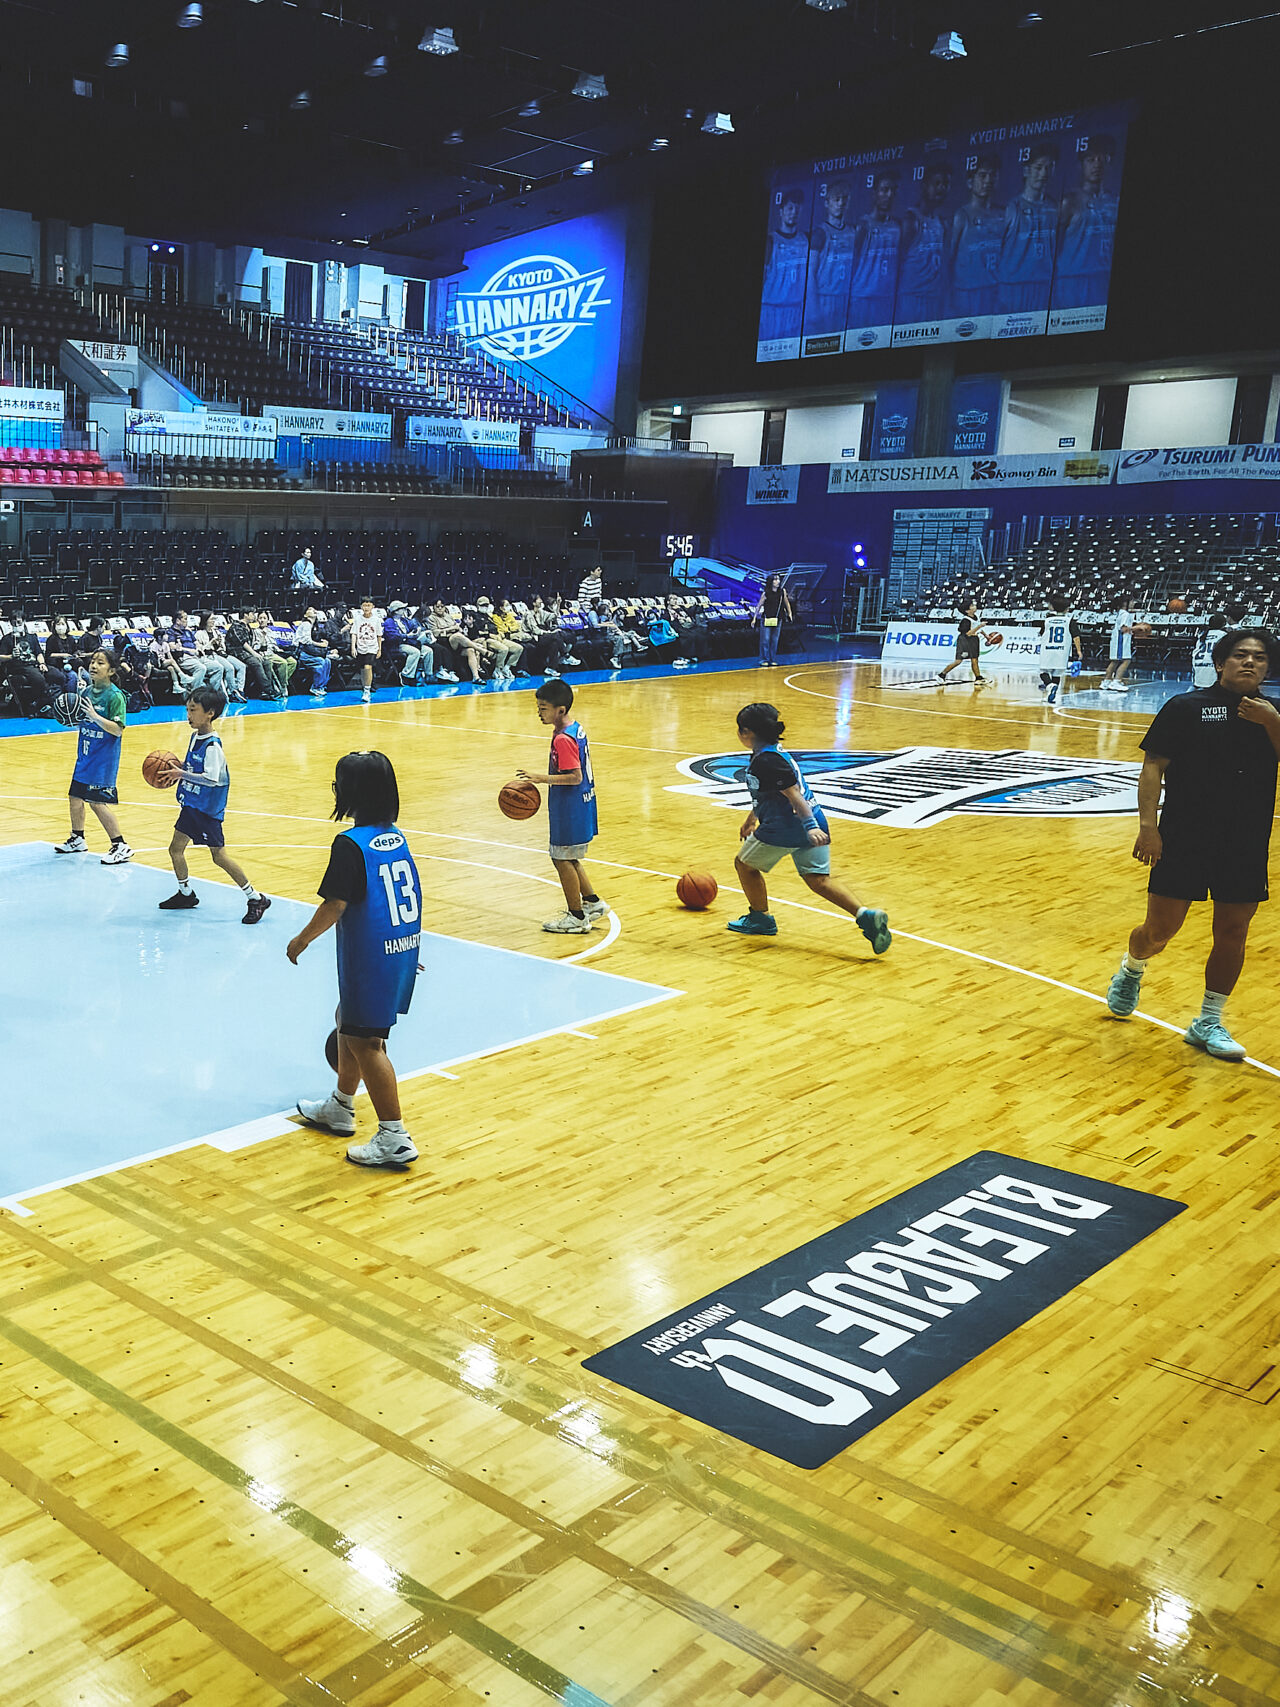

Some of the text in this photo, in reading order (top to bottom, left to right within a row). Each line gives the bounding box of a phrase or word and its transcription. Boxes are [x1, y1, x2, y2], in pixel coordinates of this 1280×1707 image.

[969, 115, 1074, 145] KYOTO HANNARYZ
[1075, 137, 1088, 152] 15
[813, 145, 904, 174] KYOTO HANNARYZ
[1017, 146, 1031, 163] 13
[965, 155, 977, 171] 12
[912, 166, 924, 181] 10
[866, 175, 875, 189] 9
[819, 183, 827, 197] 3
[775, 191, 783, 205] 0
[508, 268, 553, 288] KYOTO
[453, 275, 611, 338] HANNARYZ
[893, 326, 940, 341] FUJIFILM
[80, 341, 127, 361] 大和証券
[284, 415, 325, 430] HANNARYZ
[351, 419, 389, 435] HANNARYZ
[427, 425, 462, 439] HANNARYZ
[484, 429, 517, 443] HANNARYZ
[954, 432, 987, 444] KYOTO
[880, 436, 906, 447] KYOTO
[1163, 448, 1237, 465] TSURUMI
[844, 465, 960, 482] MATSUSHIMA
[1037, 466, 1057, 478] Bin
[1228, 467, 1240, 475] All
[754, 489, 789, 500] WINNER
[583, 511, 593, 528] A
[666, 535, 694, 557] 5:46
[886, 632, 957, 647] HORIB
[1048, 626, 1065, 643] 18
[1201, 706, 1227, 715] KYOTO
[373, 835, 402, 849] deps
[378, 859, 419, 927] 13
[759, 1173, 1114, 1358] B.LEAGUE
[641, 1302, 737, 1356] ANNIVERSARY
